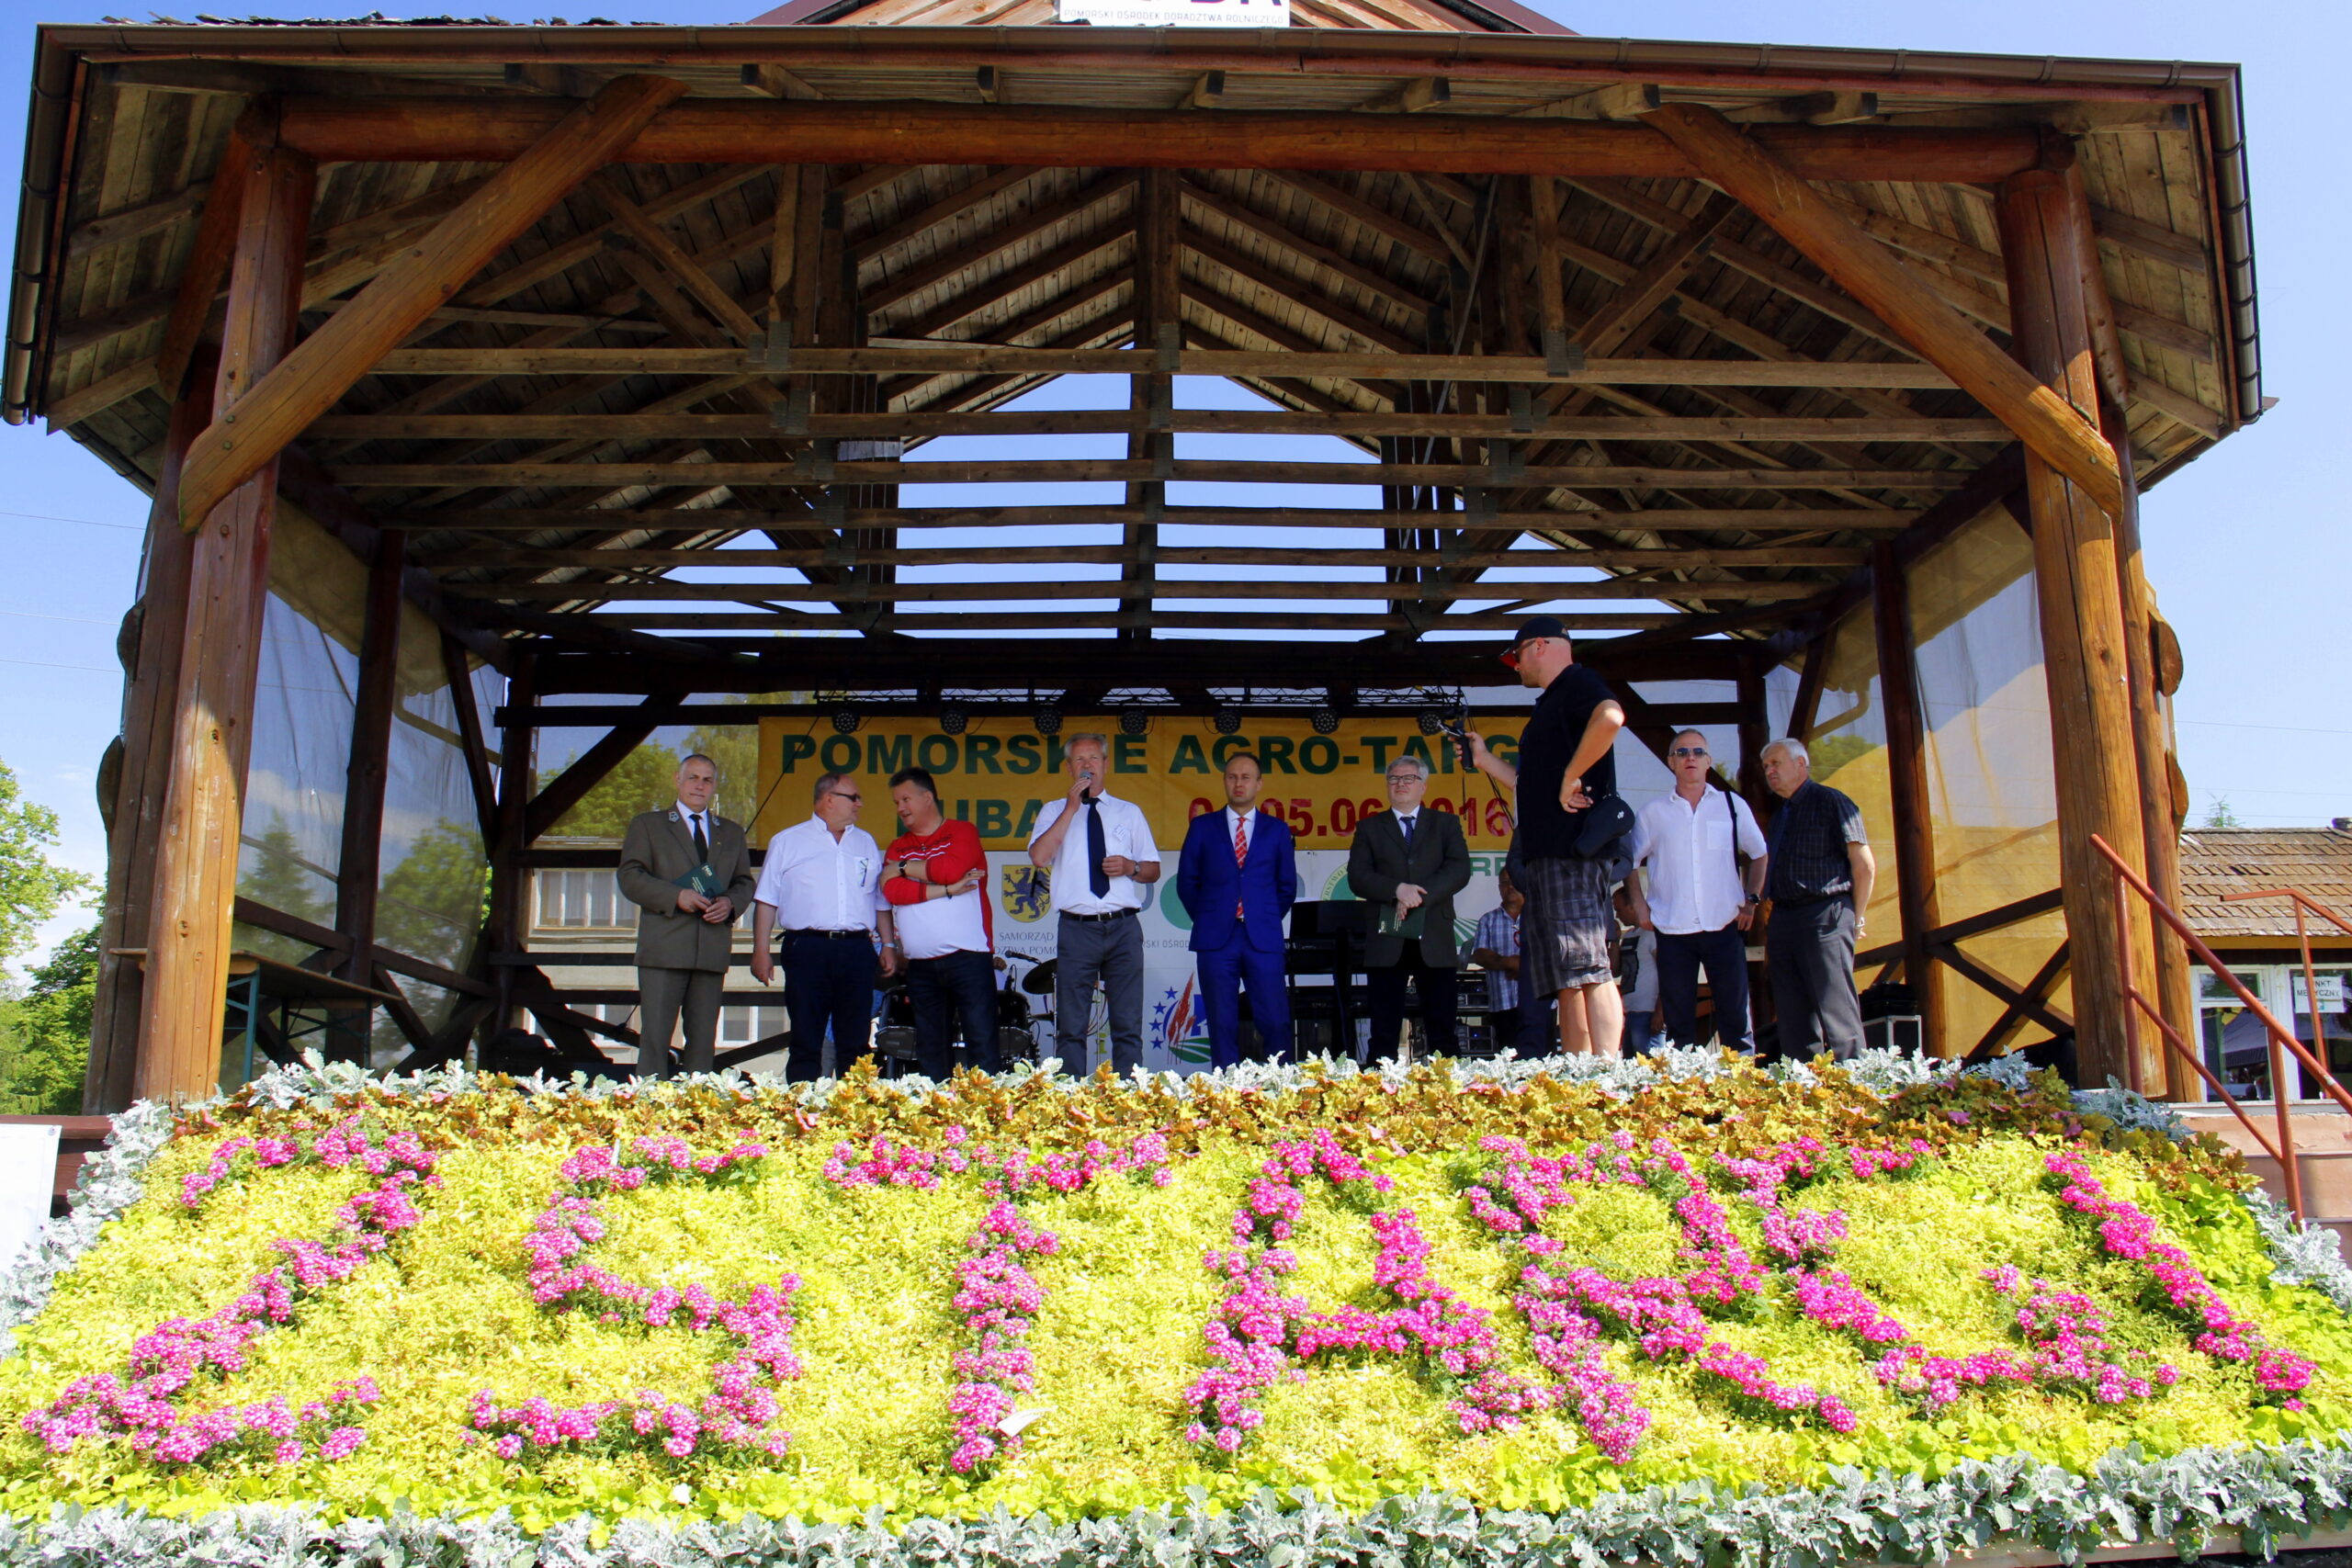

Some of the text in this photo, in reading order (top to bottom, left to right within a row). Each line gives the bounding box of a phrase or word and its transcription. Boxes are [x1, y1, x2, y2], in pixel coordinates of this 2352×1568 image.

[1064, 9, 1283, 24] POMORSKI OŚRODEK DORADZTWA ROLNICZEGO
[782, 733, 1148, 774] POMORSKE
[999, 931, 1054, 942] SAMORZĄD
[2296, 988, 2340, 997] MEYCZNY
